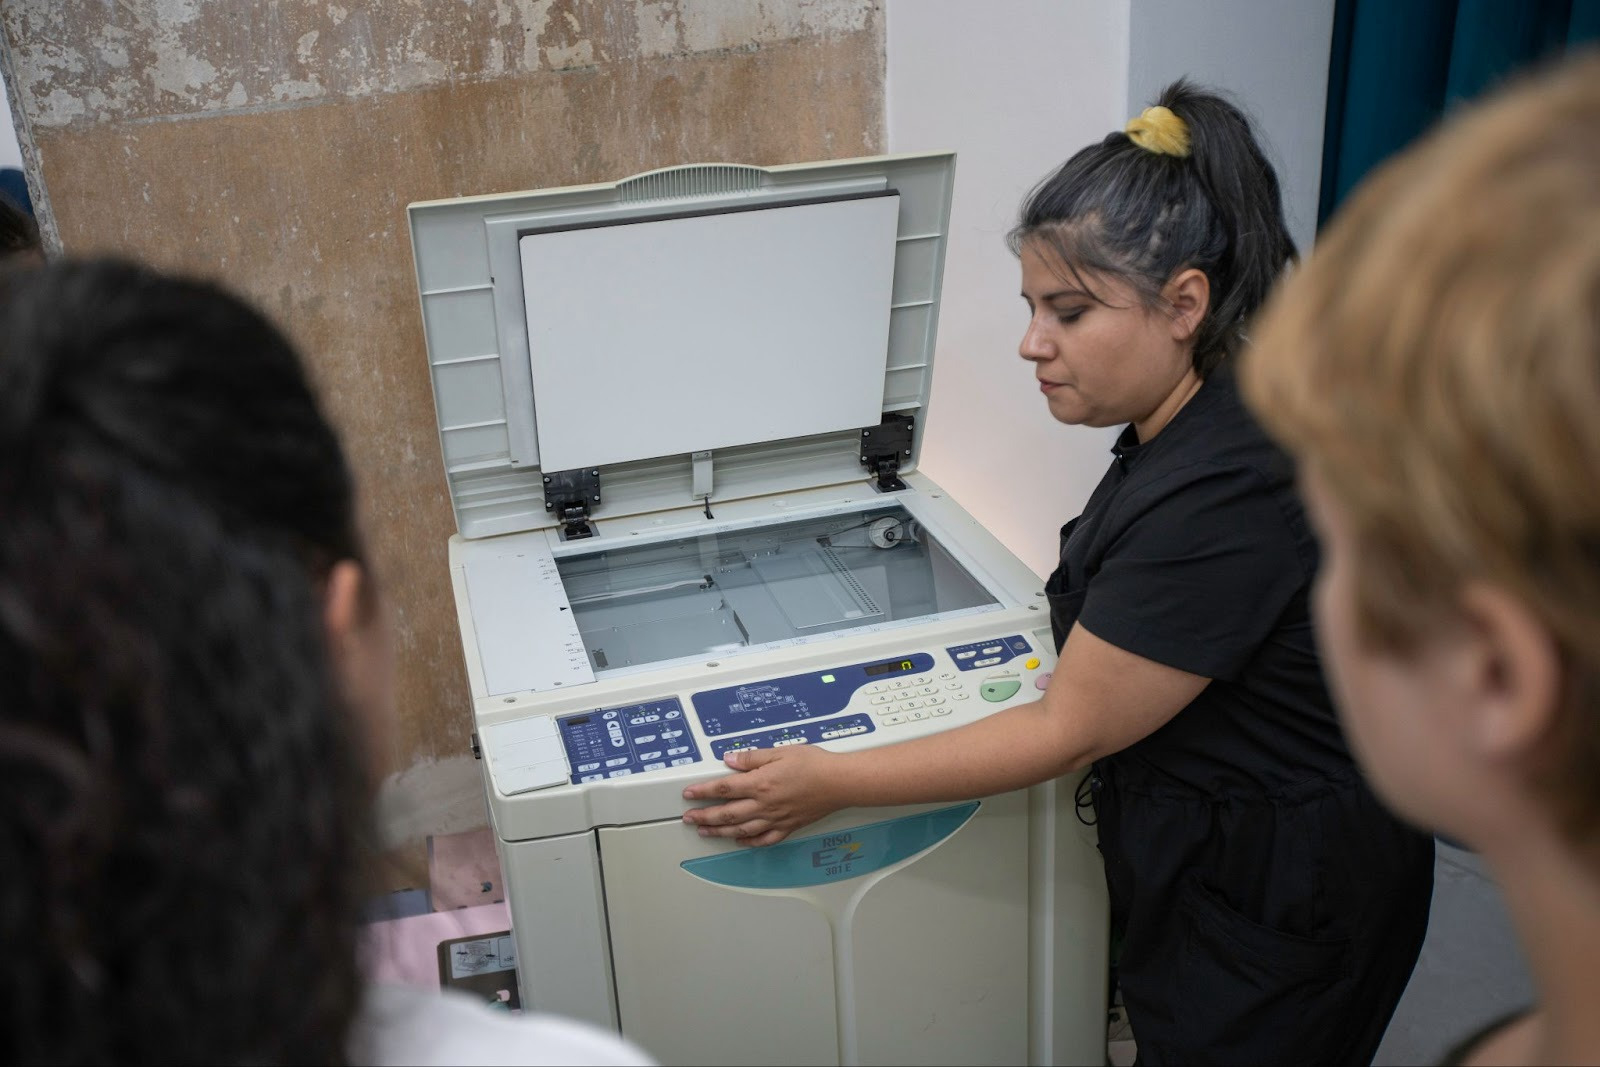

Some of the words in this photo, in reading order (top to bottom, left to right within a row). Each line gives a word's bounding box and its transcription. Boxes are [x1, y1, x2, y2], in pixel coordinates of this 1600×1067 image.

[823, 833, 852, 848] RISO
[812, 841, 865, 868] EZ
[846, 863, 852, 872] E
